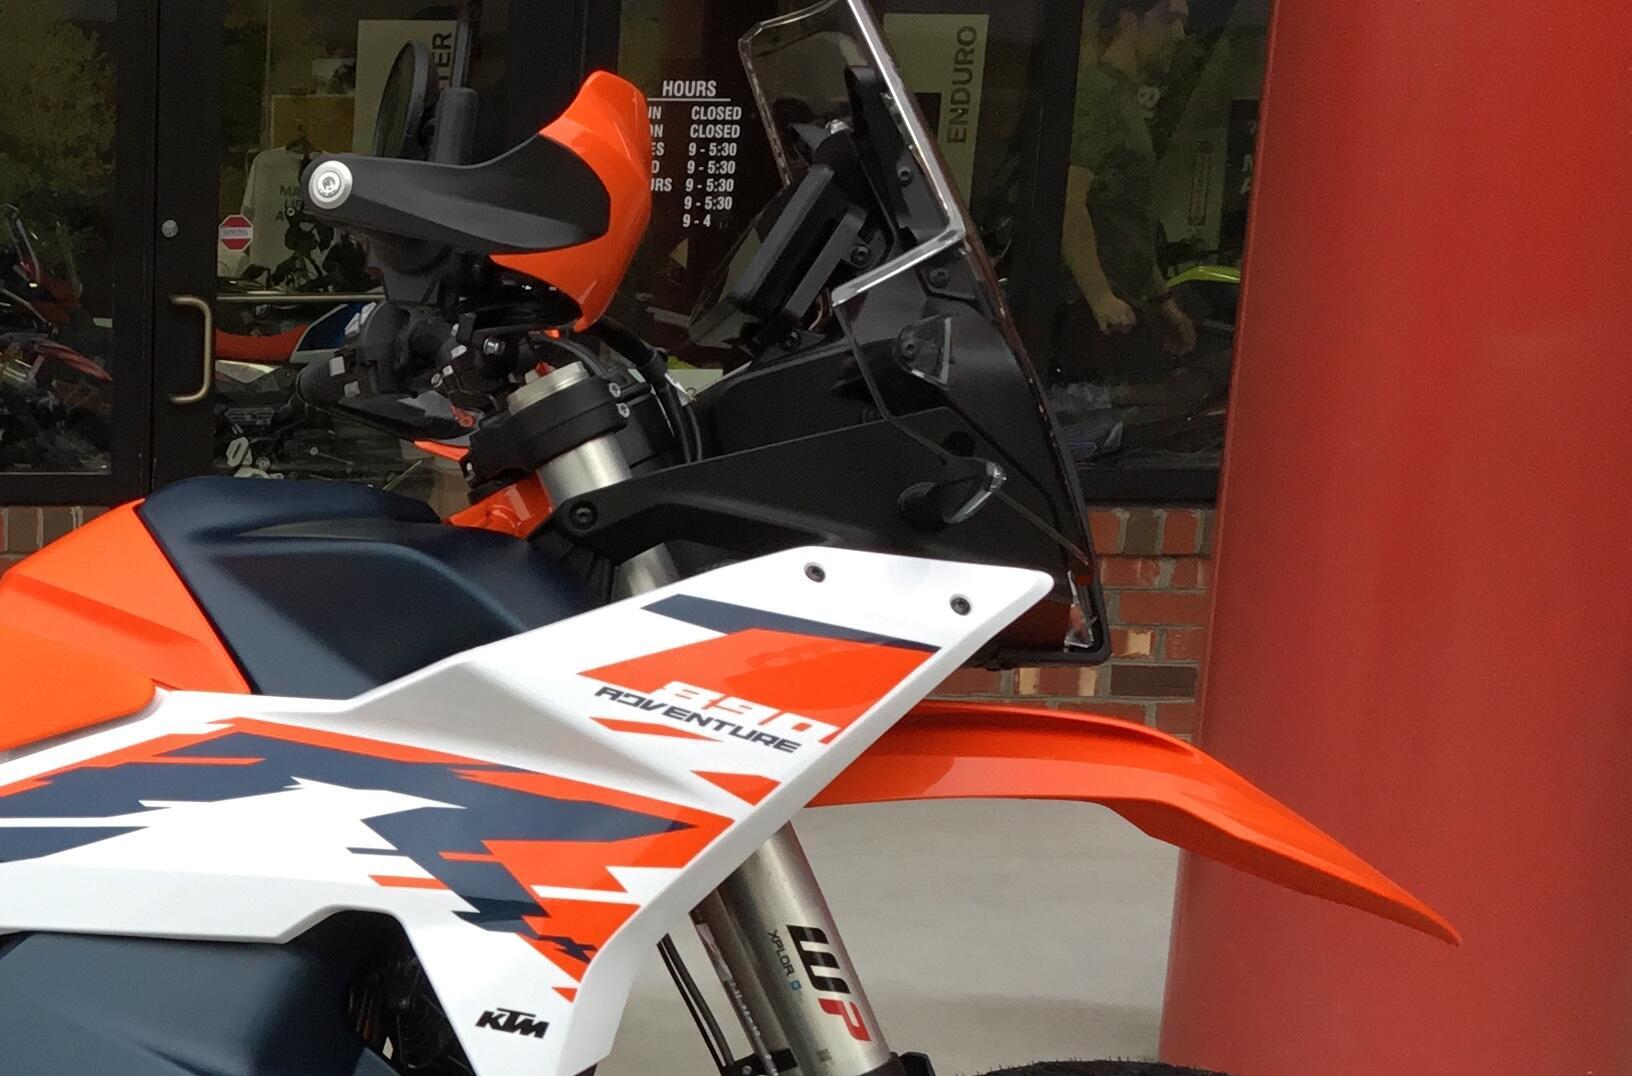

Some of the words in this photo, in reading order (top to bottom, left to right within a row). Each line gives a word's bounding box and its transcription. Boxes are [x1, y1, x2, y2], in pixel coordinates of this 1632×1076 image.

[662, 80, 717, 97] HOURS
[947, 26, 977, 143] ENDURO
[691, 105, 742, 121] CLOSED
[690, 124, 741, 139] CLOSED
[688, 142, 697, 157] 9
[708, 142, 738, 157] 5:30
[687, 160, 695, 174] 9
[707, 160, 736, 174] 5:30
[685, 178, 694, 192] 9
[705, 178, 734, 192] 5:30
[684, 196, 692, 210] 9
[704, 196, 733, 210] 5:30
[682, 214, 691, 228] 9
[702, 214, 711, 228] 4
[594, 686, 802, 754] ADVENTURE
[652, 681, 842, 743] 890
[768, 929, 796, 977] XPLOR
[786, 924, 873, 1042] WP
[475, 1007, 550, 1039] KTM
